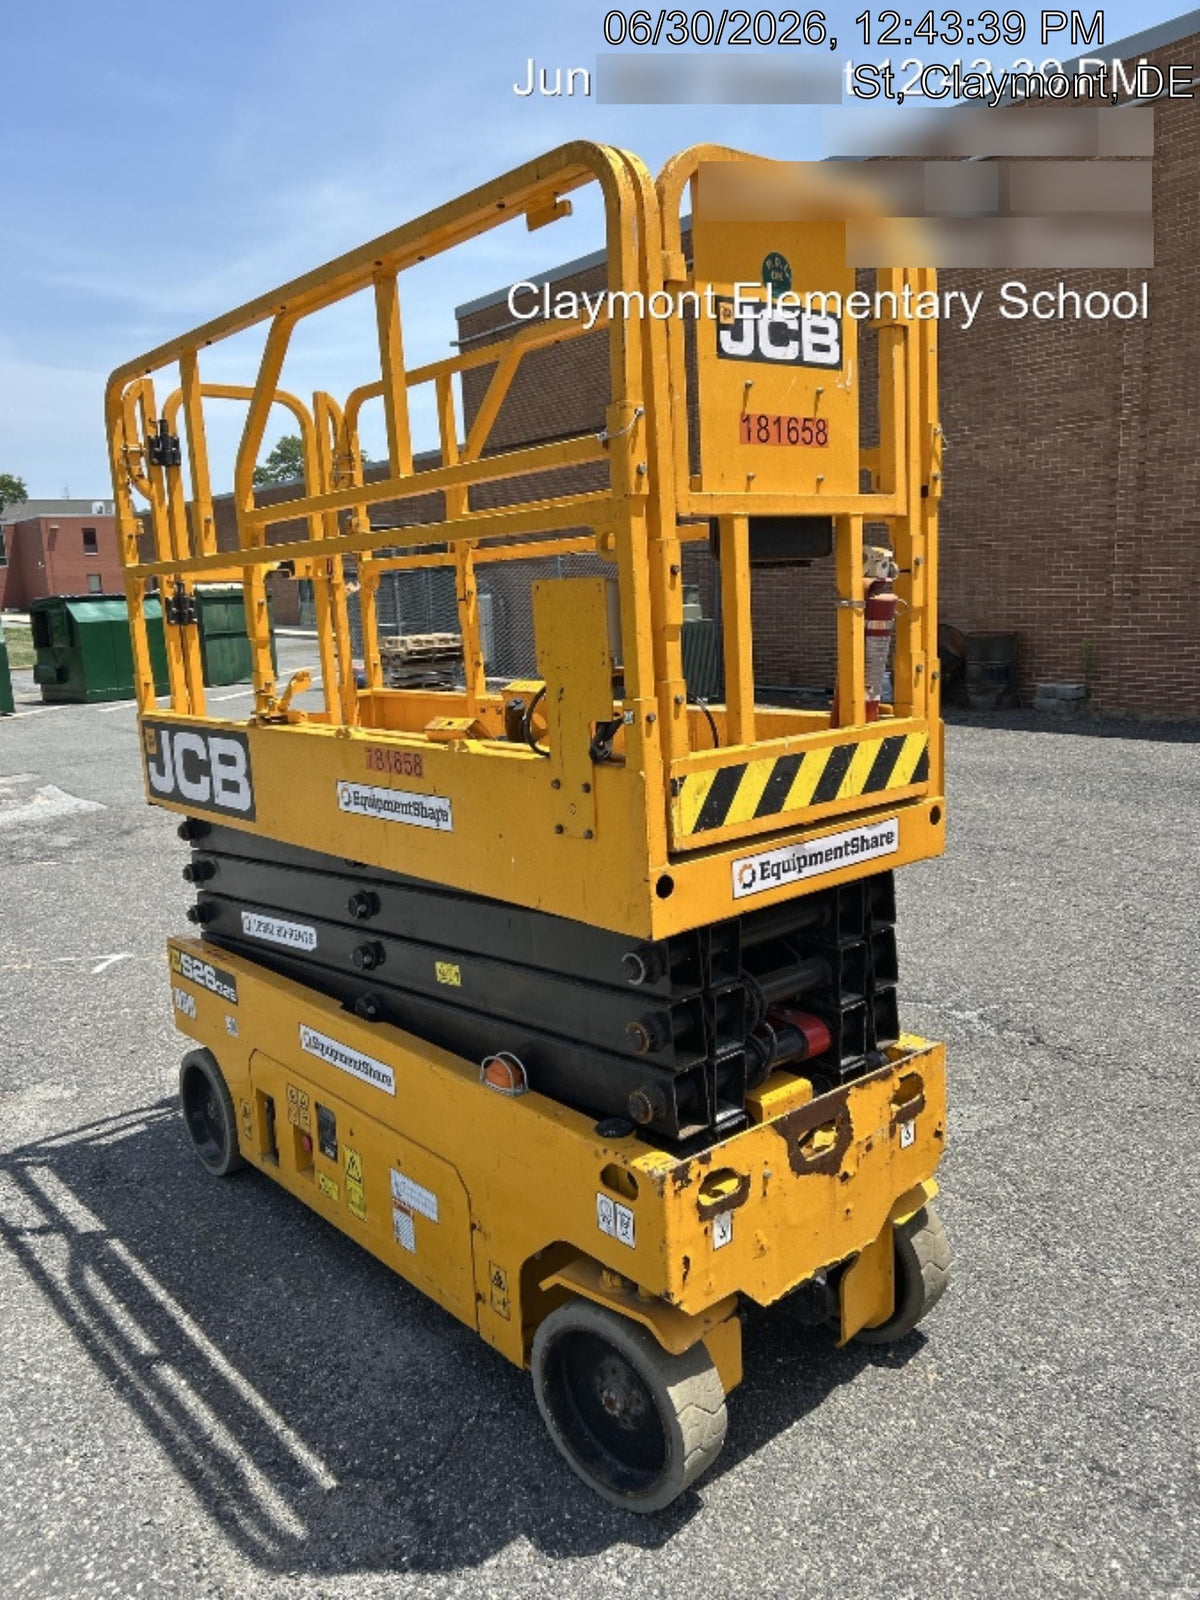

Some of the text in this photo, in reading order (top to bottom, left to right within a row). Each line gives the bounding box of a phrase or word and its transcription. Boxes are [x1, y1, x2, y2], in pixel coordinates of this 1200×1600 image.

[719, 305, 840, 365] JCB
[741, 414, 828, 446] 181658
[149, 729, 251, 811] JCB
[365, 747, 423, 777] 181658
[759, 830, 895, 881] EquipmentShare
